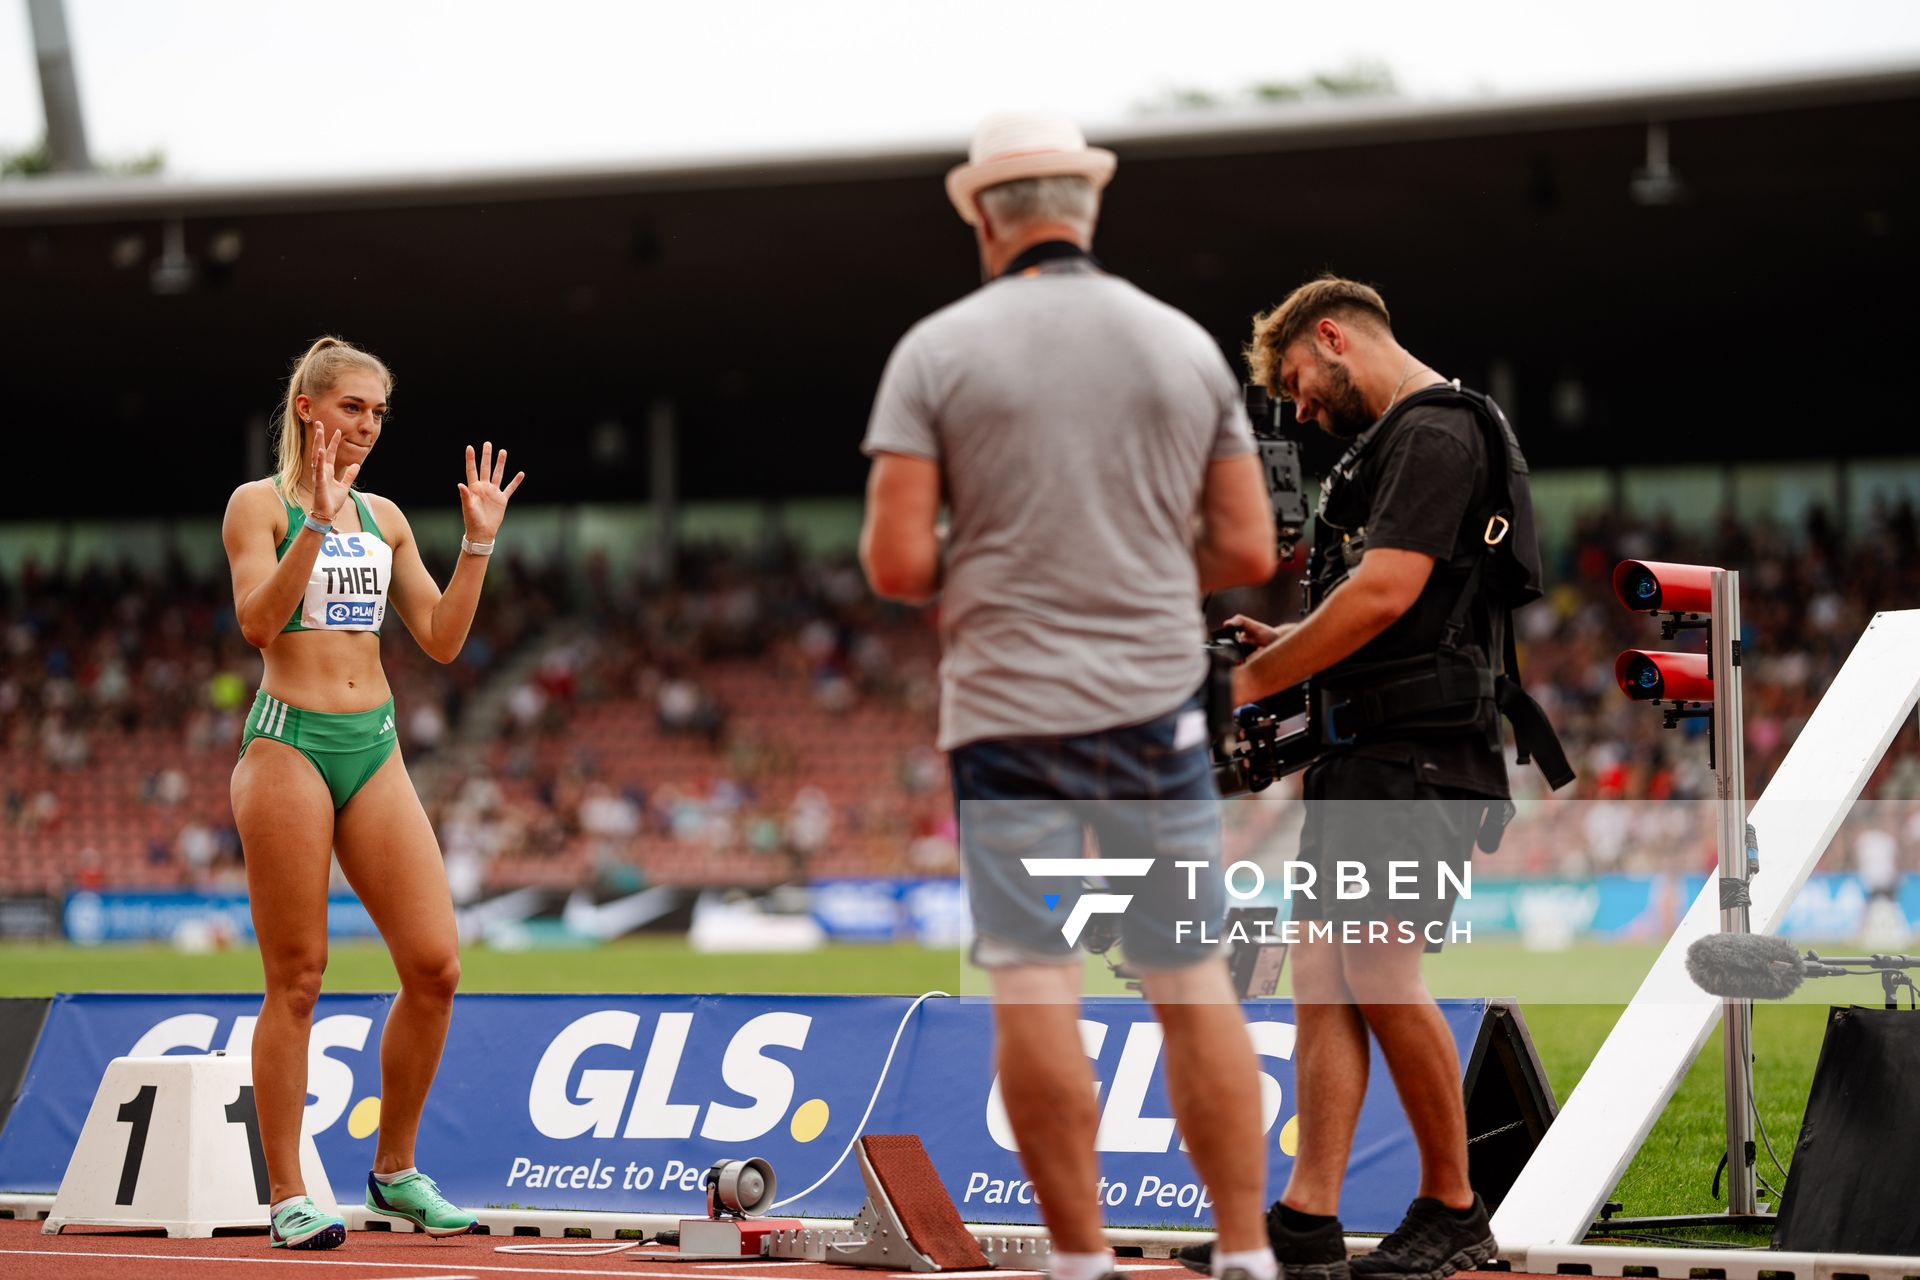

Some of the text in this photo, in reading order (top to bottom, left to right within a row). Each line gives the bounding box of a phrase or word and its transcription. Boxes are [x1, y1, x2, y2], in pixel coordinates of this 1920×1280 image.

[322, 567, 382, 595] THIEL
[115, 1085, 157, 1205] 1
[506, 1157, 616, 1190] Parcels
[623, 1161, 655, 1191] to
[963, 1172, 1042, 1205] Parc
[1095, 1176, 1128, 1207] to
